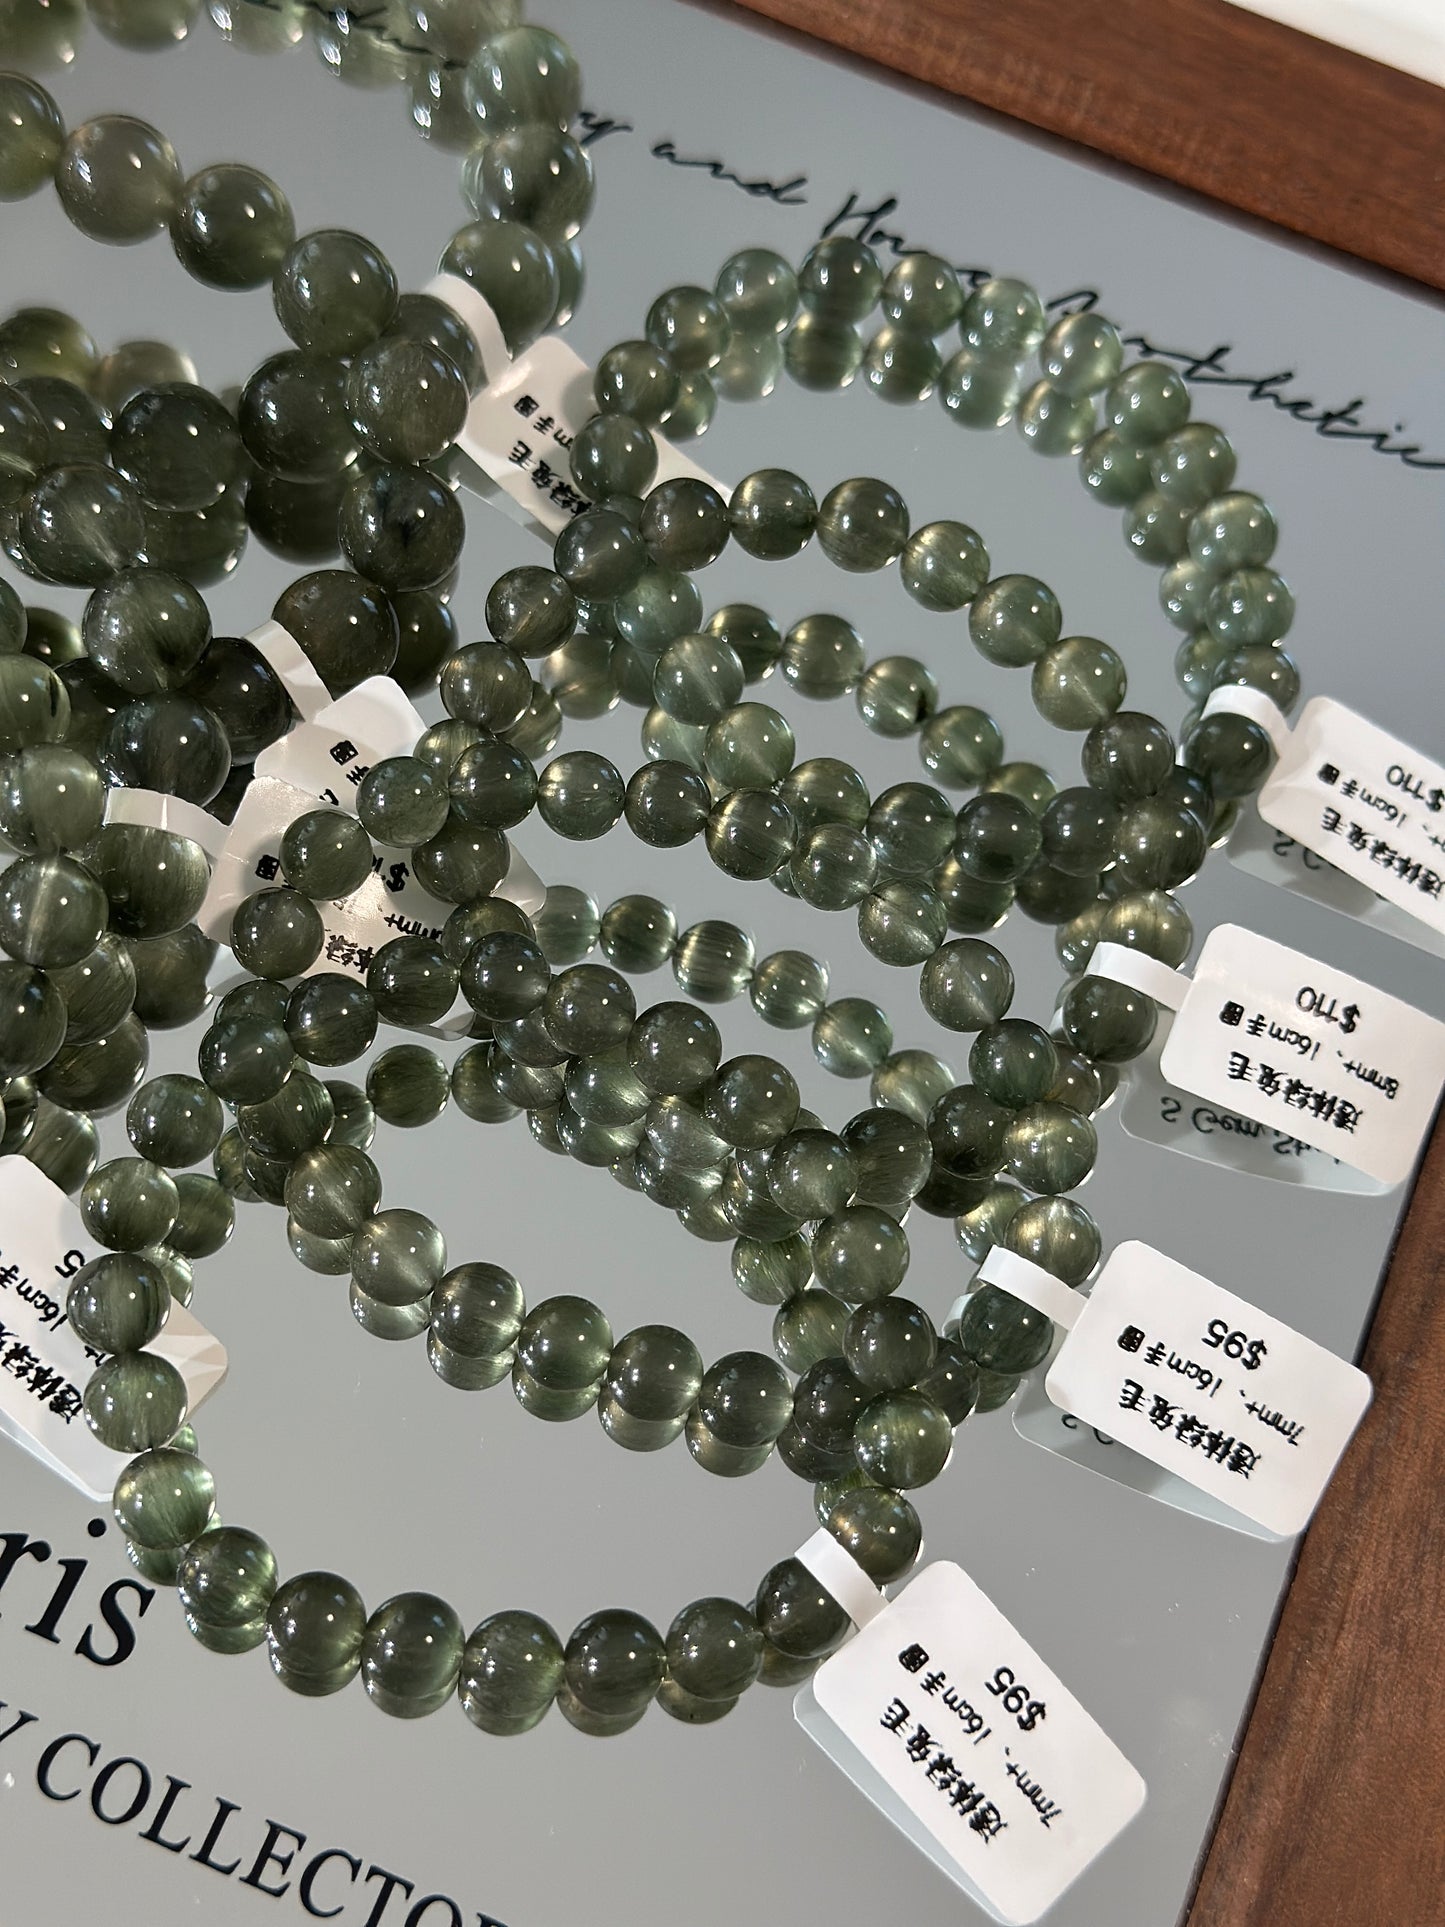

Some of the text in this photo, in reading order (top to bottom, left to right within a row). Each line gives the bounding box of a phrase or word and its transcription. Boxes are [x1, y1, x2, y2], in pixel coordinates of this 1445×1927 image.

[1296, 986, 1361, 1034] $110
[1201, 1318, 1268, 1370] $95
[984, 1666, 1047, 1731] $95
